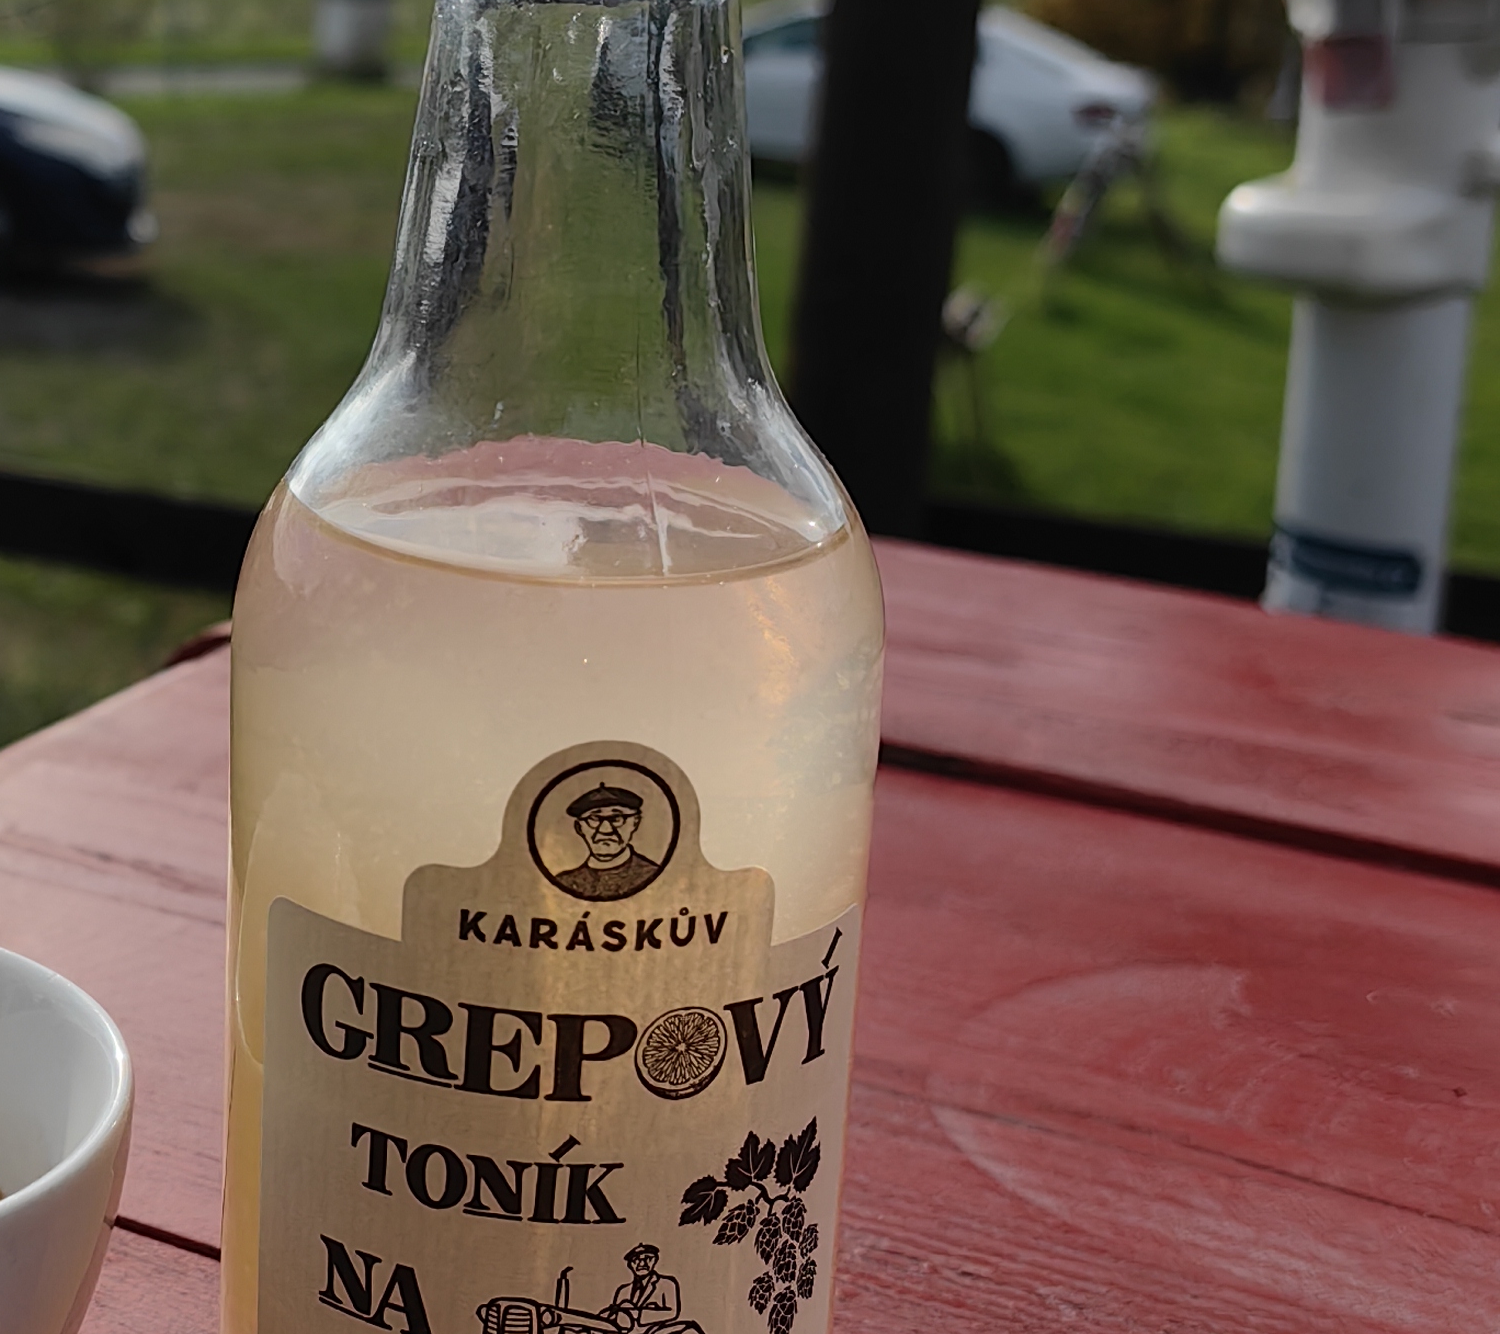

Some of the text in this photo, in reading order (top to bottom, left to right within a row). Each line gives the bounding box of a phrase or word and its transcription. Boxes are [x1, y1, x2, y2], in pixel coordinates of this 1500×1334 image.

[458, 906, 728, 953] KARÁSKŮV
[301, 927, 842, 1102] GREPOVÝ
[350, 1122, 626, 1225] TONÍK
